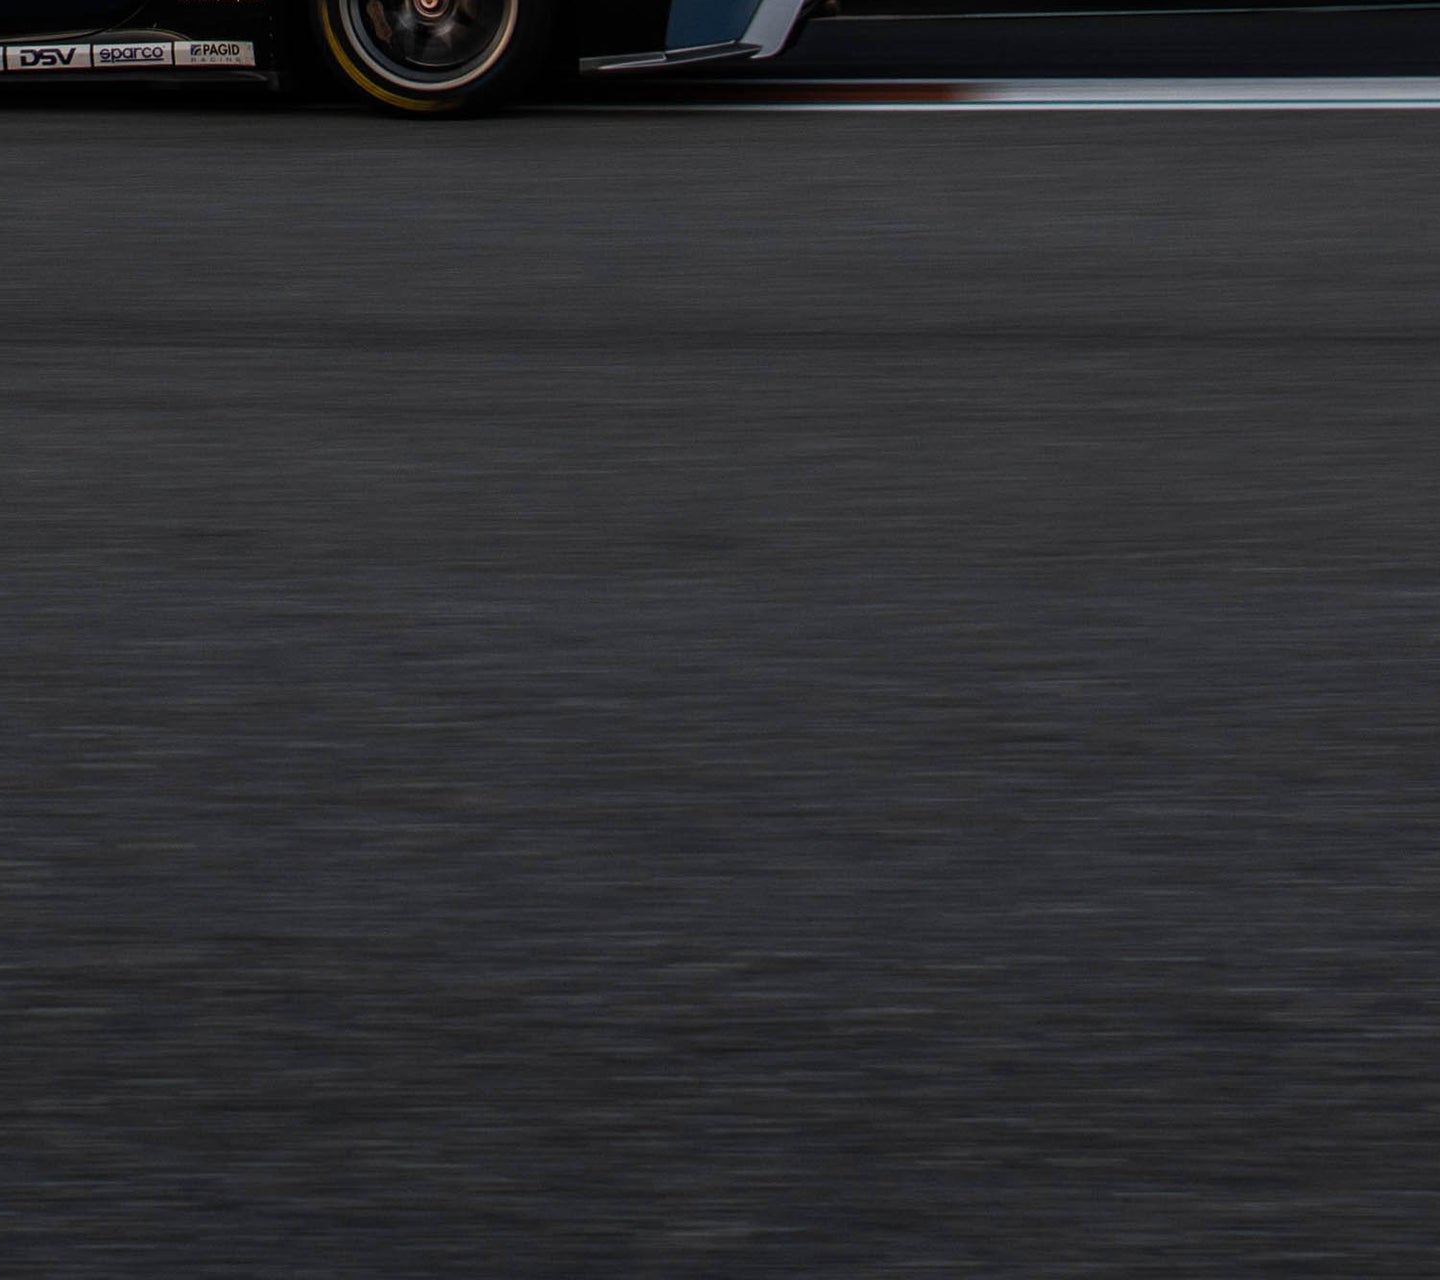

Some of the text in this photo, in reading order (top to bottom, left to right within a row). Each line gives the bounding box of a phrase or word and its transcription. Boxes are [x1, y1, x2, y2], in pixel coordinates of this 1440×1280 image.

[20, 47, 77, 66] DSV
[99, 46, 164, 62] sparco
[203, 43, 240, 56] PAGID
